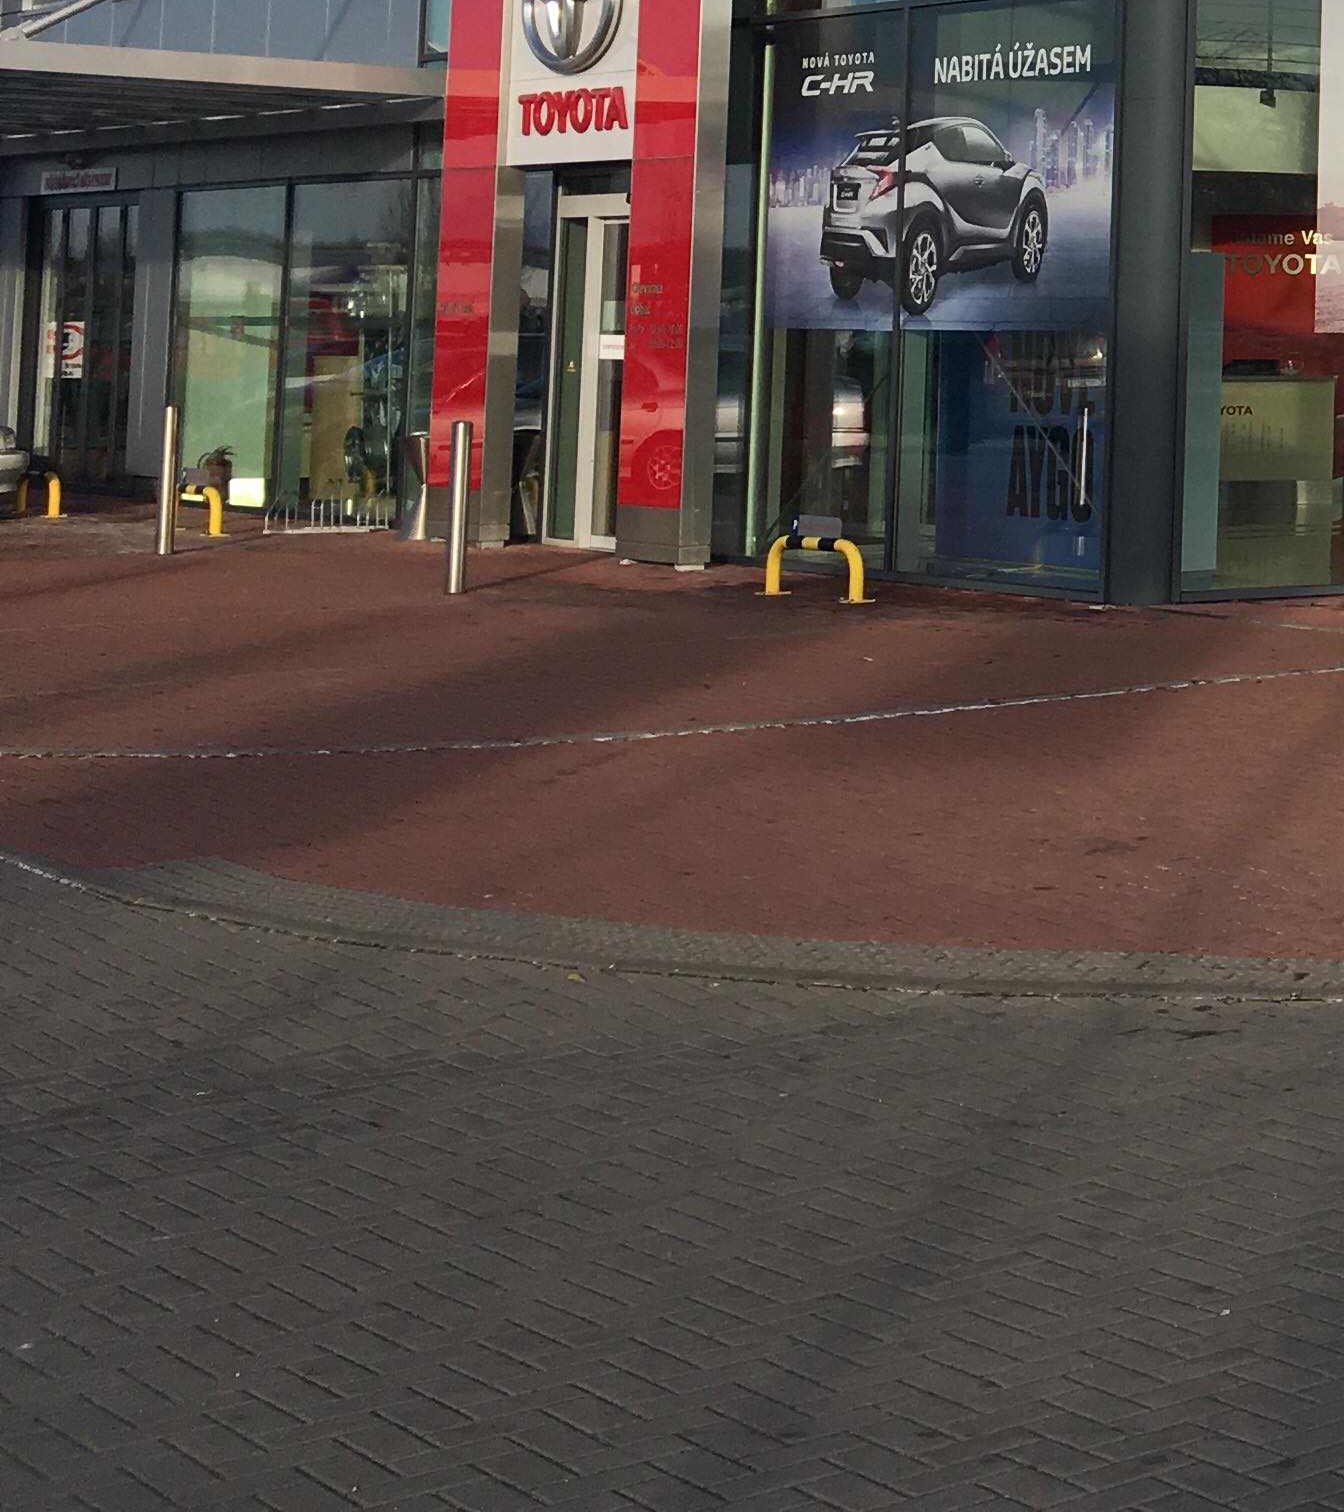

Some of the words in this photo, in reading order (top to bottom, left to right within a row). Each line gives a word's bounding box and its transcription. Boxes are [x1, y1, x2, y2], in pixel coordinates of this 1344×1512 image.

[802, 51, 830, 69] NOVÁ
[833, 51, 875, 67] TOYOTA
[934, 43, 1005, 85] NABITÁ
[1008, 41, 1092, 79] ÚŽASEM
[801, 70, 875, 97] C-HR
[517, 85, 629, 137] TOYOTA
[1225, 252, 1342, 276] TOYOTA
[1220, 405, 1253, 416] YOTA
[1006, 425, 1094, 523] AYGO
